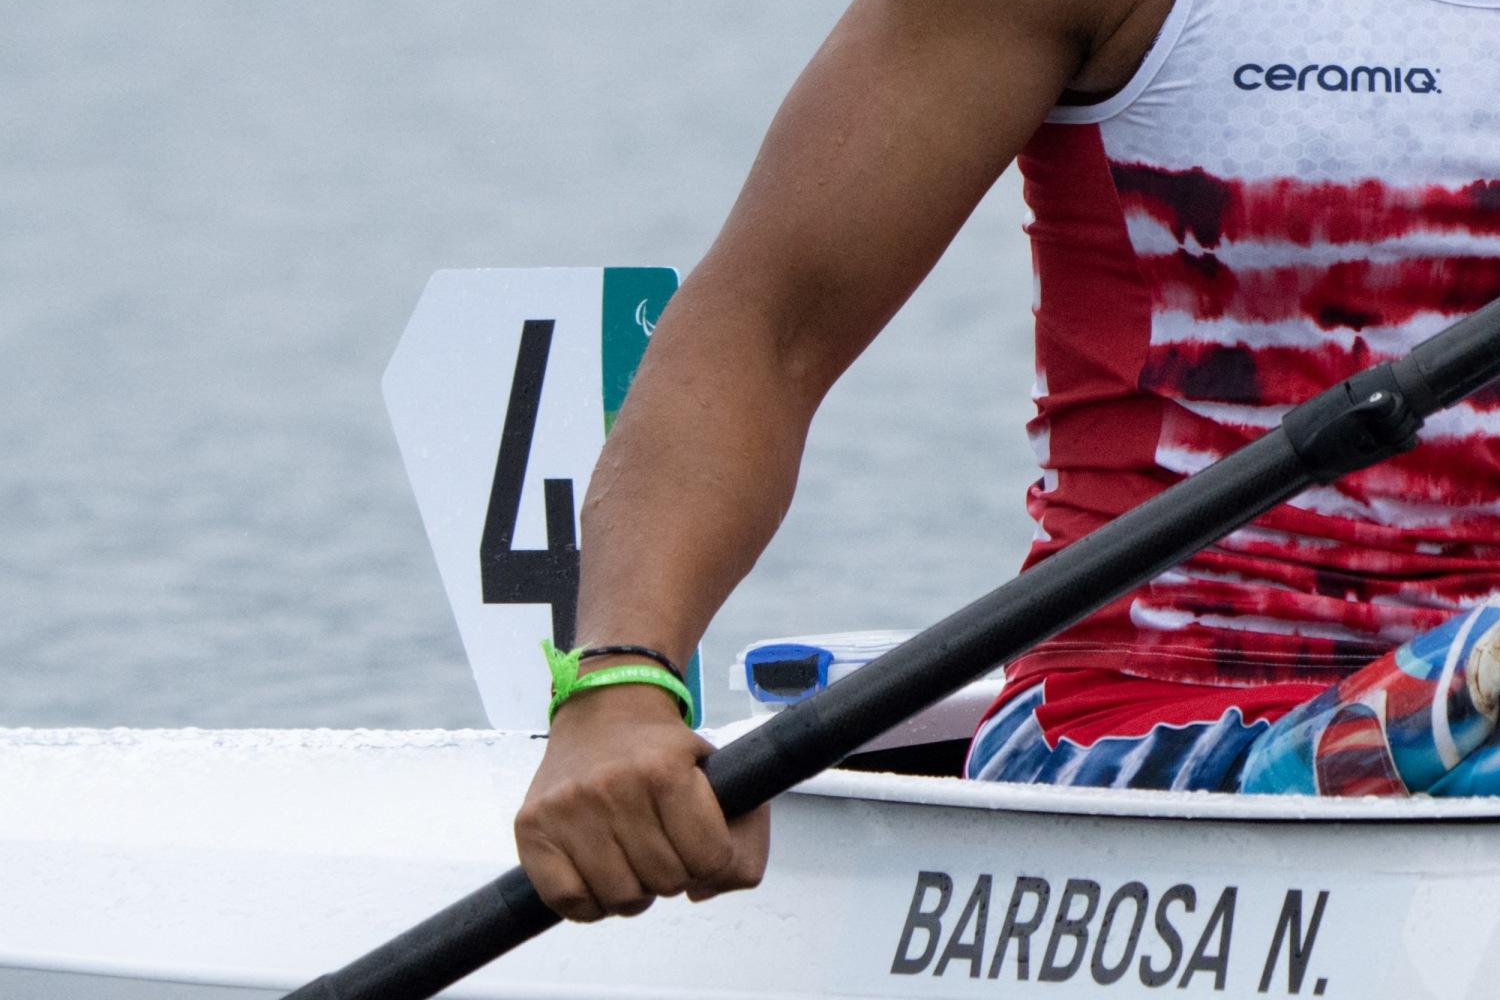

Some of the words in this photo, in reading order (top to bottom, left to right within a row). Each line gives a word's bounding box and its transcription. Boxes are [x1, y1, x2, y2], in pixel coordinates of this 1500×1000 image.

[480, 319, 580, 653] 4
[890, 870, 1238, 990] BARBOSA
[1257, 889, 1330, 996] N.
